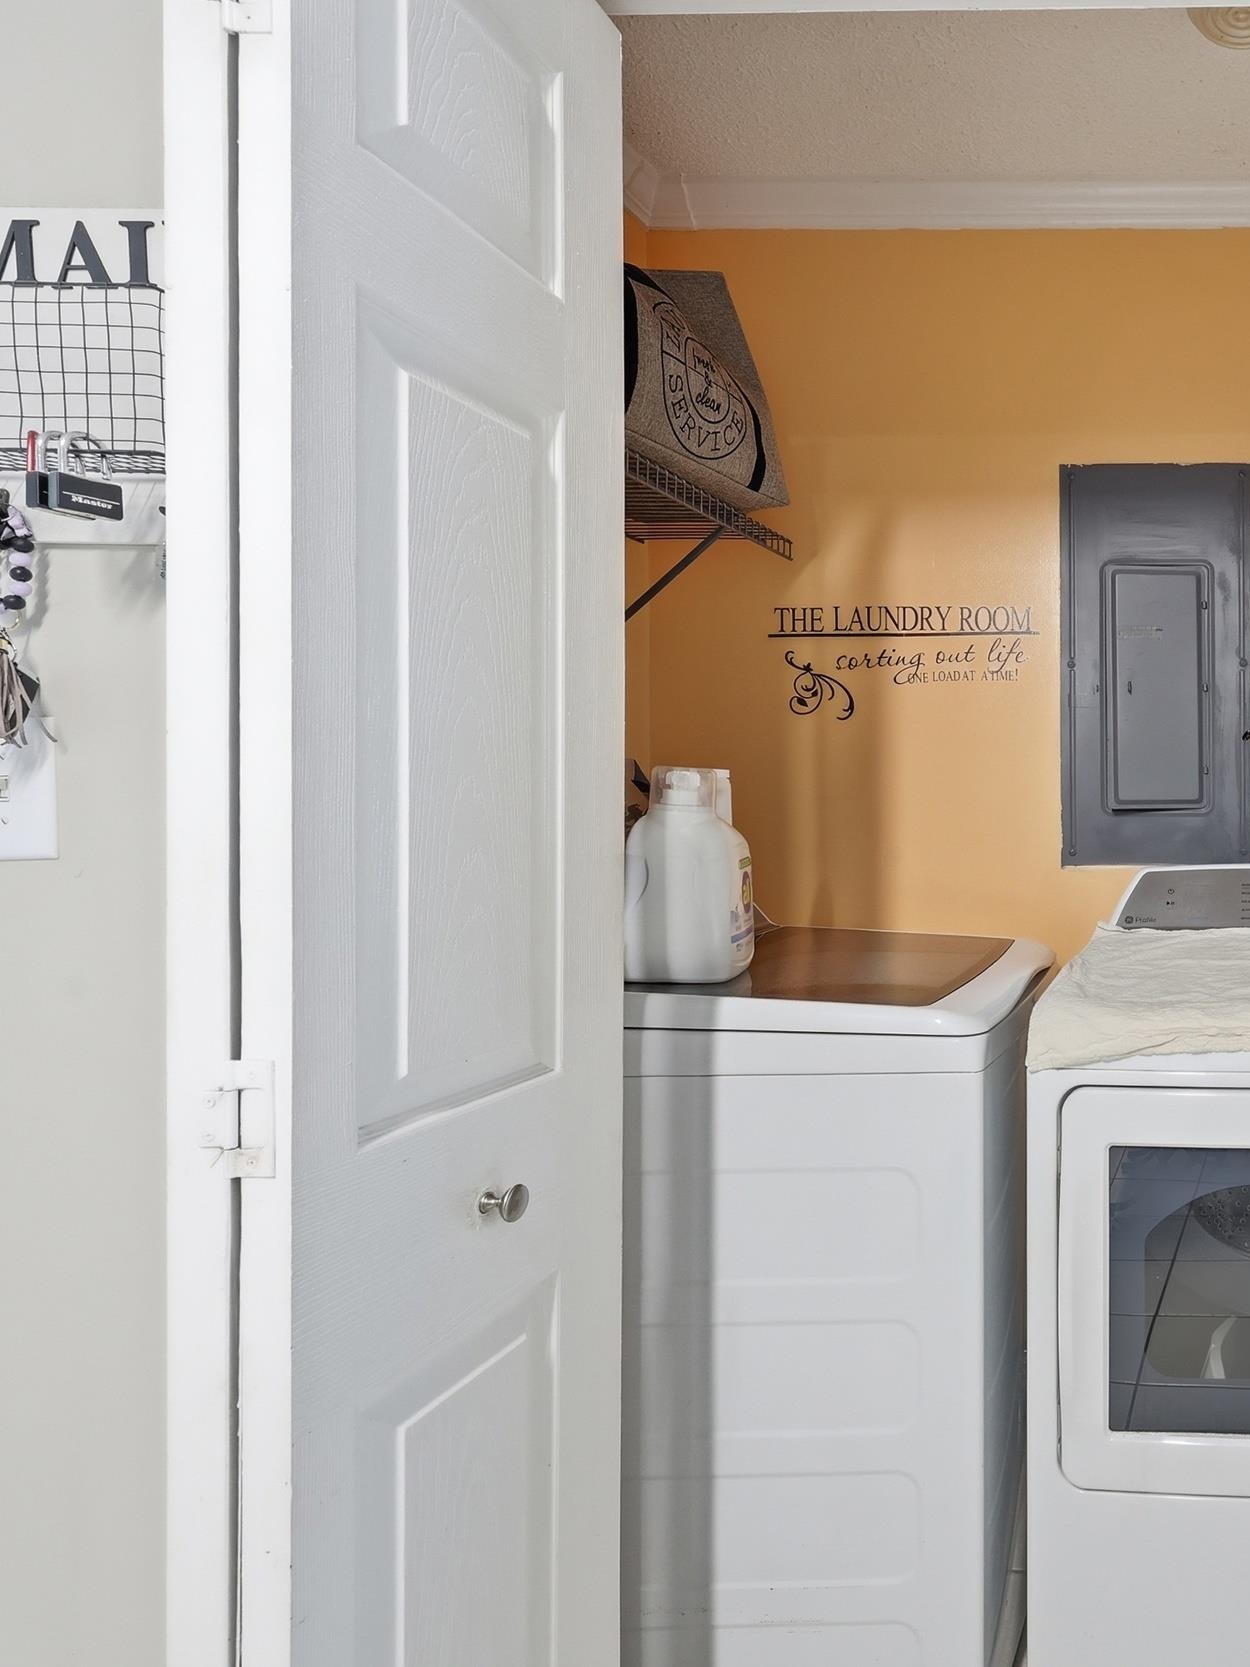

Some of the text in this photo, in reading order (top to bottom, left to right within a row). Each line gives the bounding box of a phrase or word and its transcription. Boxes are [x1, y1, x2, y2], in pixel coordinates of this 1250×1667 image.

[0, 219, 165, 289] MAI
[669, 374, 744, 452] SERVICE
[696, 386, 721, 414] clean
[71, 495, 113, 510] Master
[774, 605, 1032, 634] THE LAUNDRY ROOM
[835, 646, 926, 686] sorting
[935, 644, 976, 664] out
[907, 672, 929, 685] ONE
